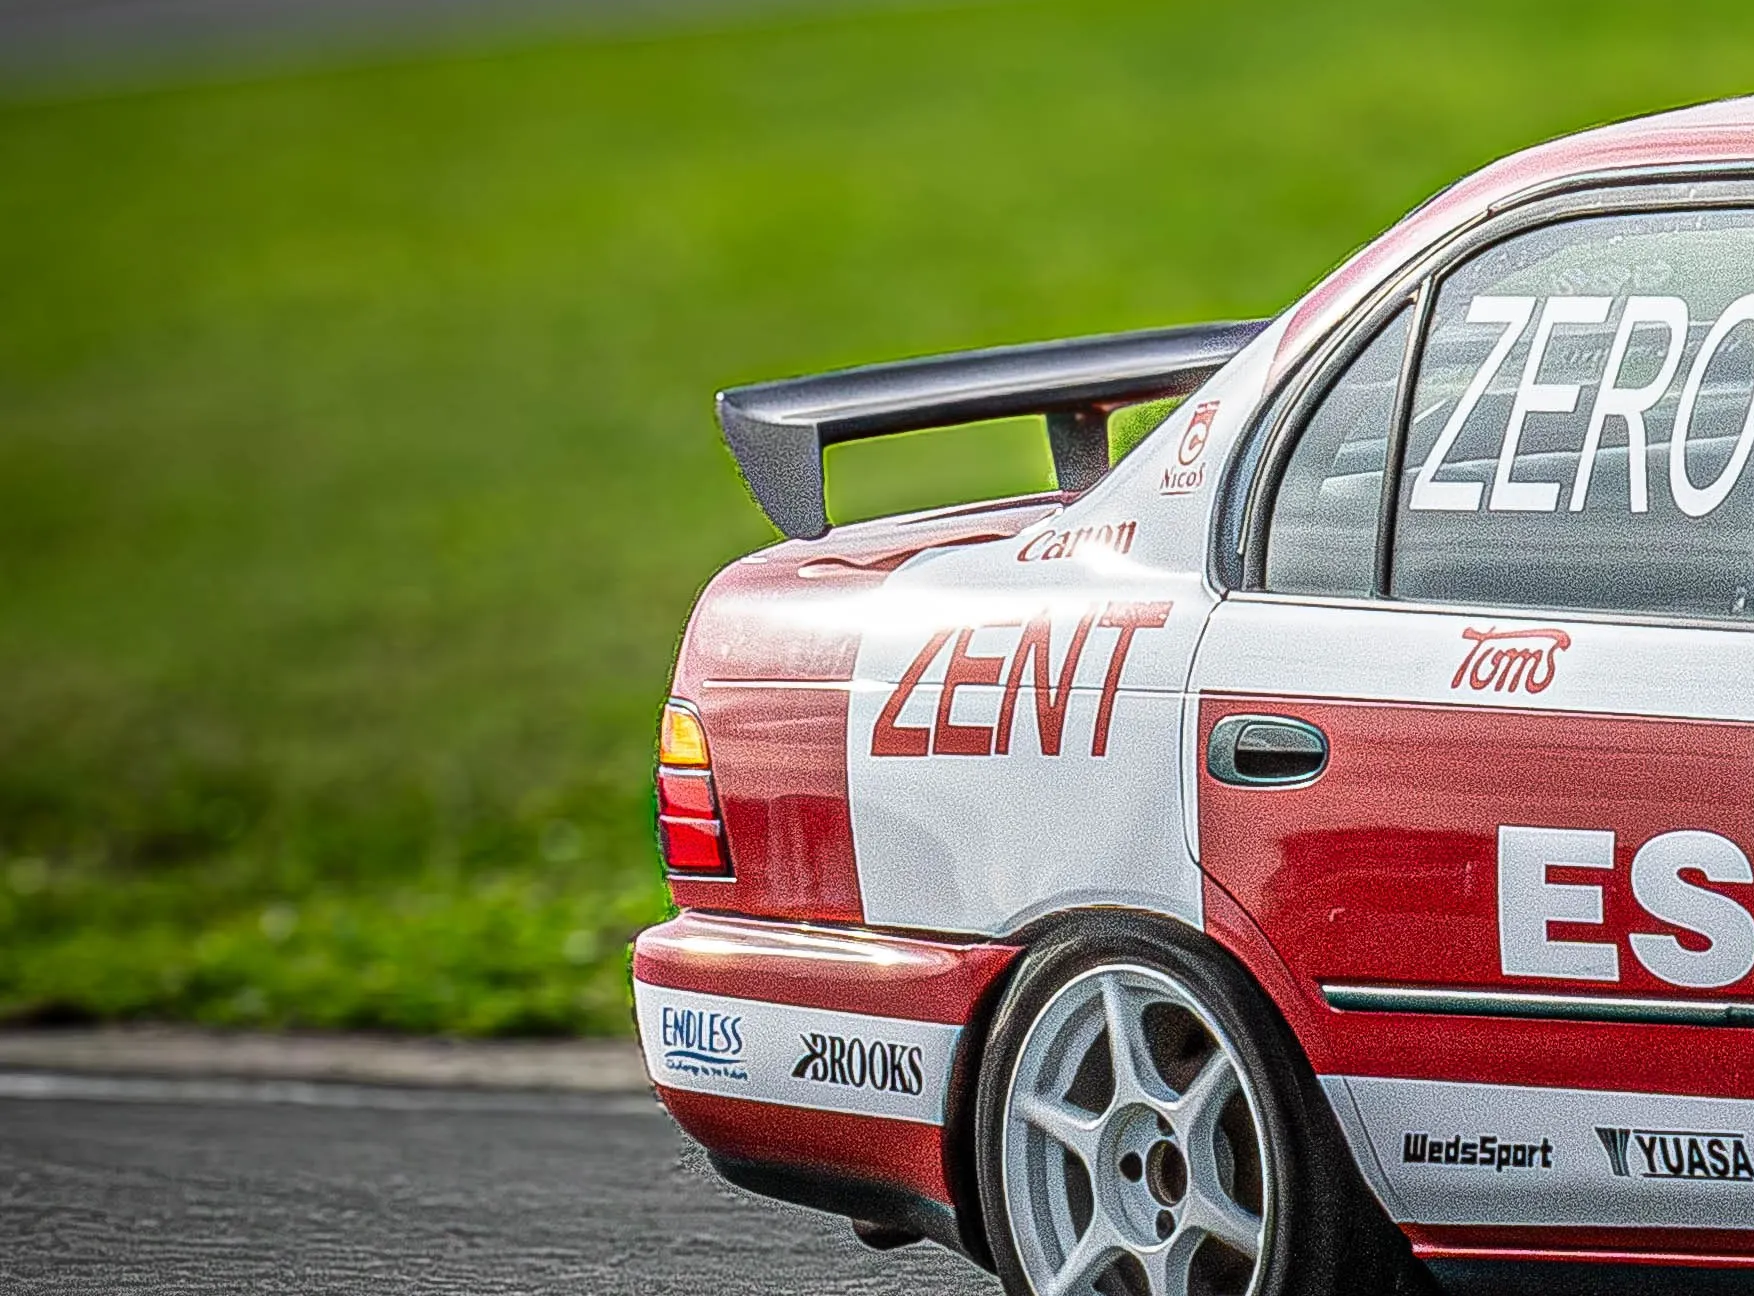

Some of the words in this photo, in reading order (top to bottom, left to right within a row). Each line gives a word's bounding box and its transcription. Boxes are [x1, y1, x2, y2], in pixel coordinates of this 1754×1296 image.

[1017, 521, 1137, 562] Canon
[871, 601, 1174, 757] ZENT
[662, 1006, 743, 1055] ENDLESS
[791, 1032, 923, 1096] BROOKS
[1403, 1132, 1553, 1172] WedsSport
